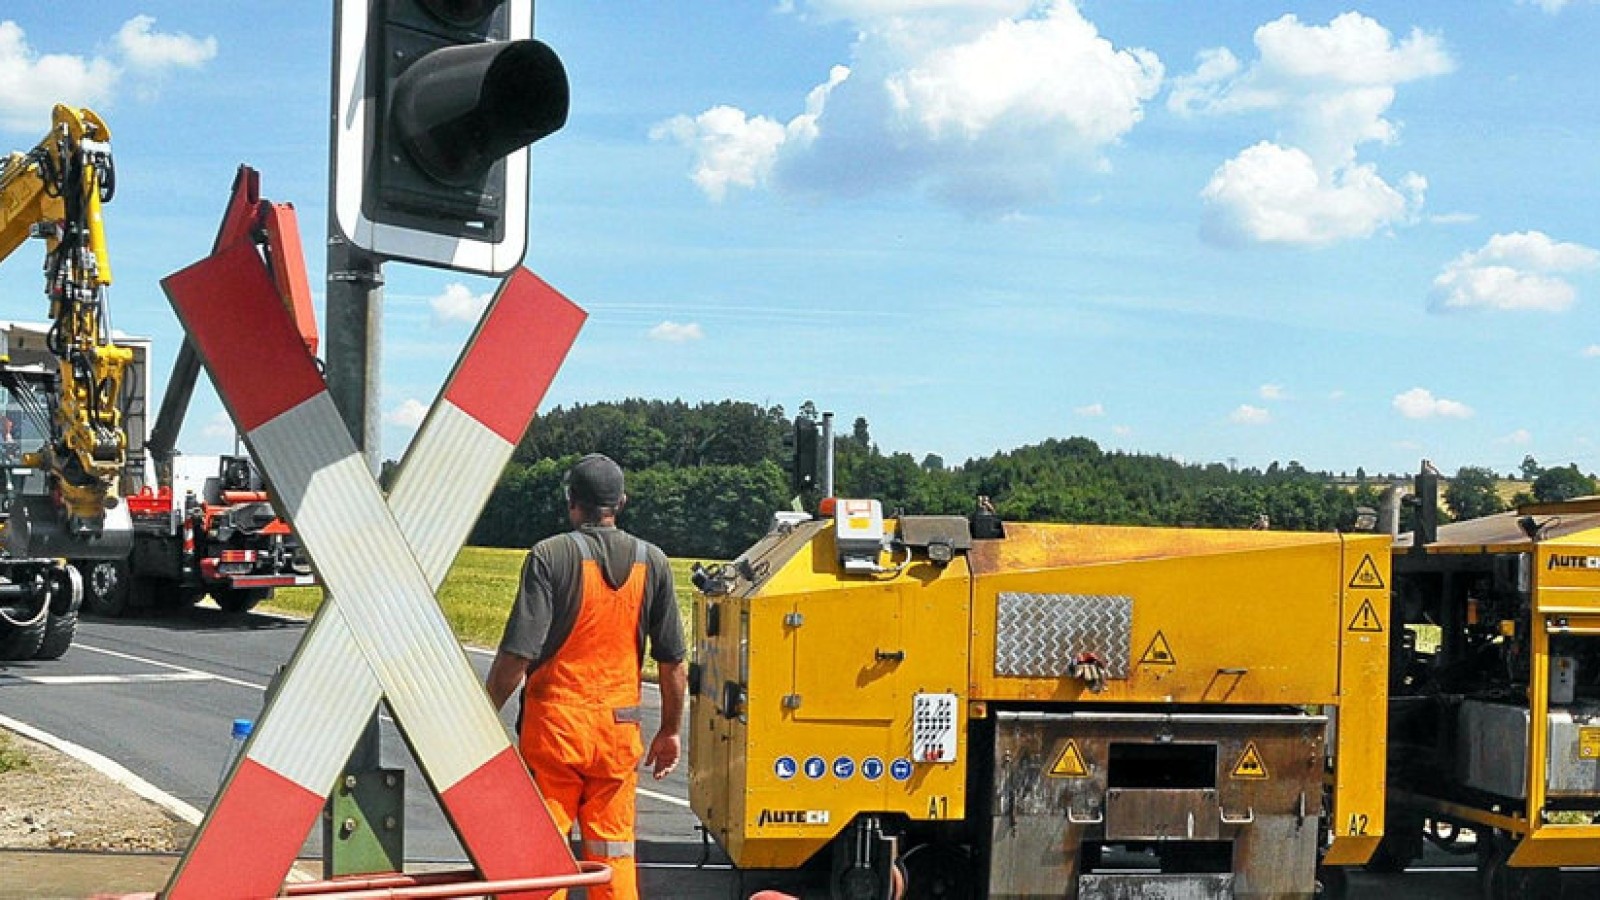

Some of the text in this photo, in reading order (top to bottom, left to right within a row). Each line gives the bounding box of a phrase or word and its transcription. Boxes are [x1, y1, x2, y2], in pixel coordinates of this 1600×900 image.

[758, 808, 829, 826] AUTECH
[929, 796, 948, 820] A1
[1349, 813, 1367, 837] A2
